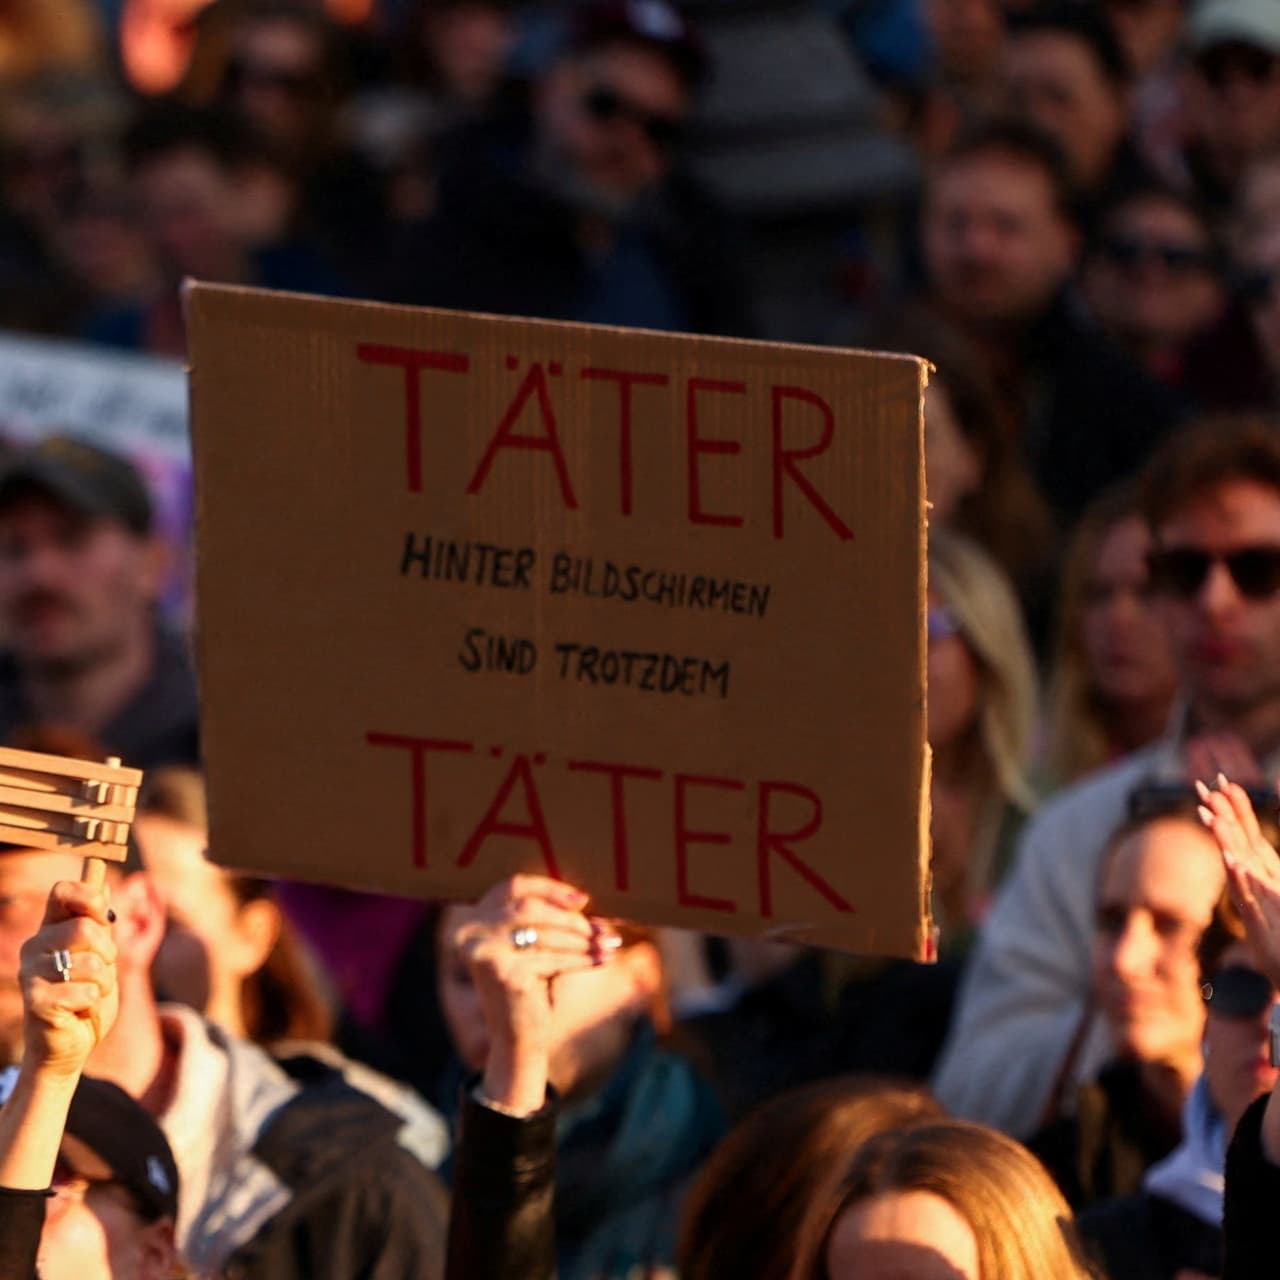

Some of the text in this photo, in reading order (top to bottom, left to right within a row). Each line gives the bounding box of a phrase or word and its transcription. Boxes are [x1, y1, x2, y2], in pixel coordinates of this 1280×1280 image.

[357, 343, 854, 542] TÄTER
[401, 532, 771, 617] HINTER BILDSCHIRMEN
[458, 627, 730, 698] SIND TROTZDEM
[366, 732, 855, 918] TÄTER
